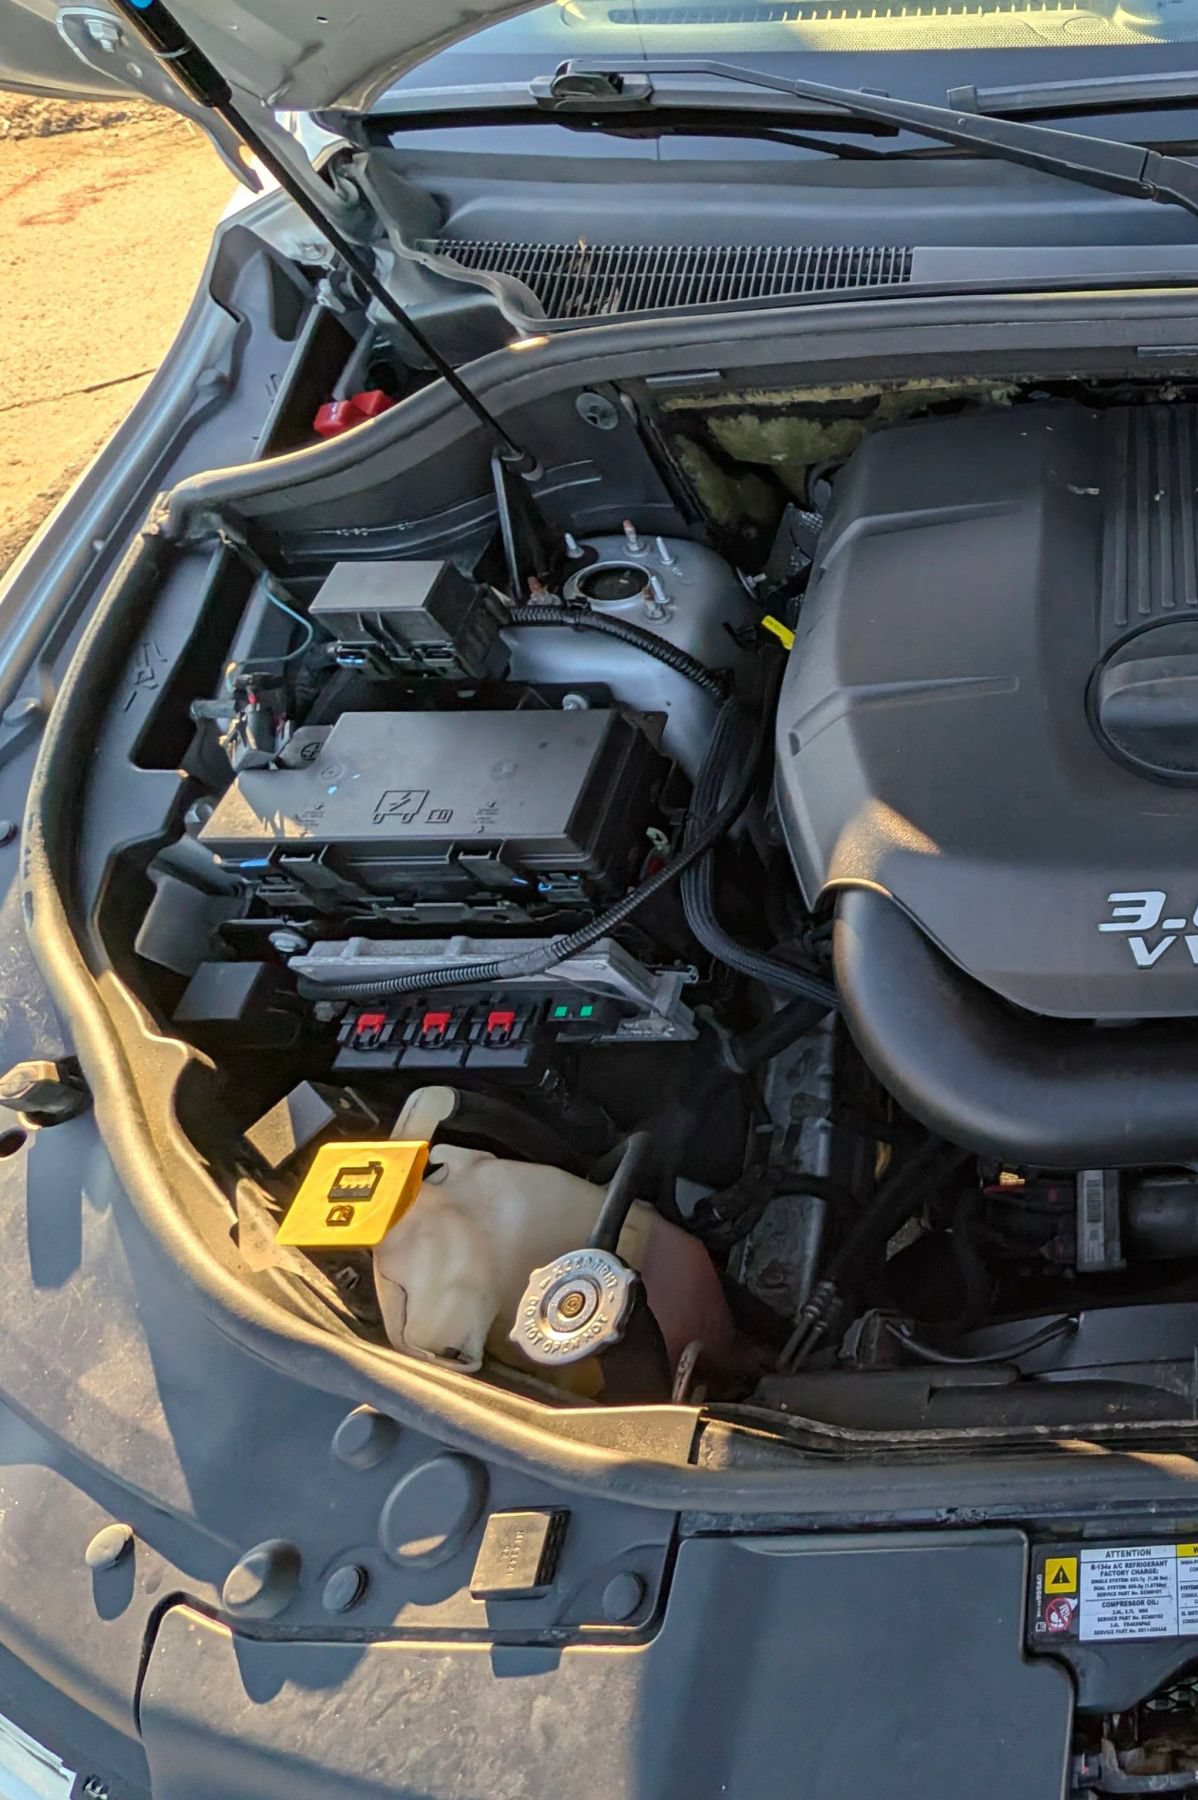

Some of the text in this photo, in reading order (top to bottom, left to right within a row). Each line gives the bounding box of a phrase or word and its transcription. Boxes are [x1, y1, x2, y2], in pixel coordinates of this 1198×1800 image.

[554, 1257, 618, 1289] KEEP TIGHT
[524, 1295, 609, 1354] DO NOT OPEN HOT
[1105, 1549, 1152, 1558] ATTENTION
[1091, 1560, 1168, 1571] R-134a A/C REFRIGERANT
[1100, 1568, 1159, 1577] FACTORY CHARGE:
[1102, 1600, 1145, 1608] COMPRESSOR
